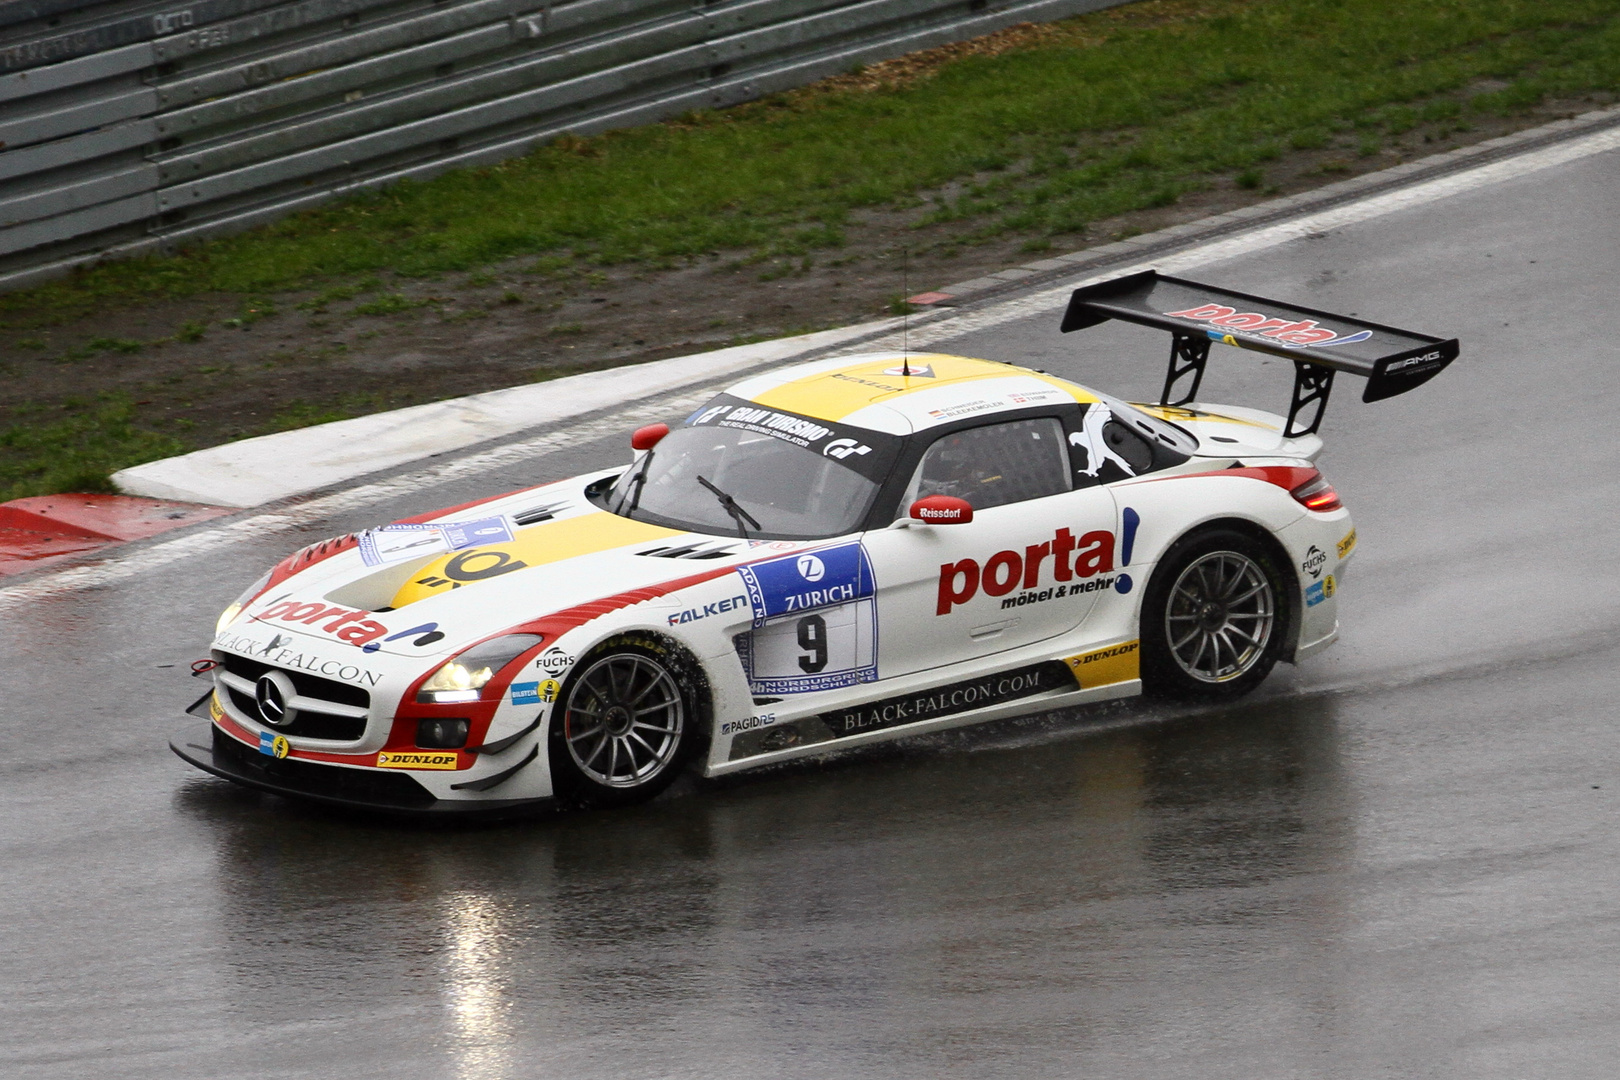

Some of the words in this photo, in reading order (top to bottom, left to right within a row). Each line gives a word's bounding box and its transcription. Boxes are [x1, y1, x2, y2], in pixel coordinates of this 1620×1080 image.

[1404, 351, 1440, 367] AMG
[725, 406, 767, 424] GRAN
[941, 400, 985, 413] SCHNEIDER
[946, 401, 1005, 417] BLEEKEMOLEN
[718, 420, 730, 428] THE
[730, 421, 745, 429] REAL
[745, 424, 771, 435] DRIVING
[770, 429, 810, 448] SIMULATOR
[920, 507, 961, 518] Reissdorf
[1302, 551, 1327, 572] FUCHS
[738, 567, 760, 603] ADAC
[1001, 587, 1054, 610] möbel
[1055, 586, 1067, 598] &
[1069, 577, 1115, 596] mehr
[785, 584, 854, 612] ZURICH
[667, 595, 747, 626] FALKEN
[797, 614, 829, 674] 9
[1083, 643, 1138, 666] DUNLOP
[274, 649, 384, 687] FALCON
[536, 656, 575, 668] FUCHS
[512, 689, 537, 698] BILSTEIN
[844, 671, 1040, 731] BLACK-FALCON.COM
[391, 755, 455, 765] DUNLOP
